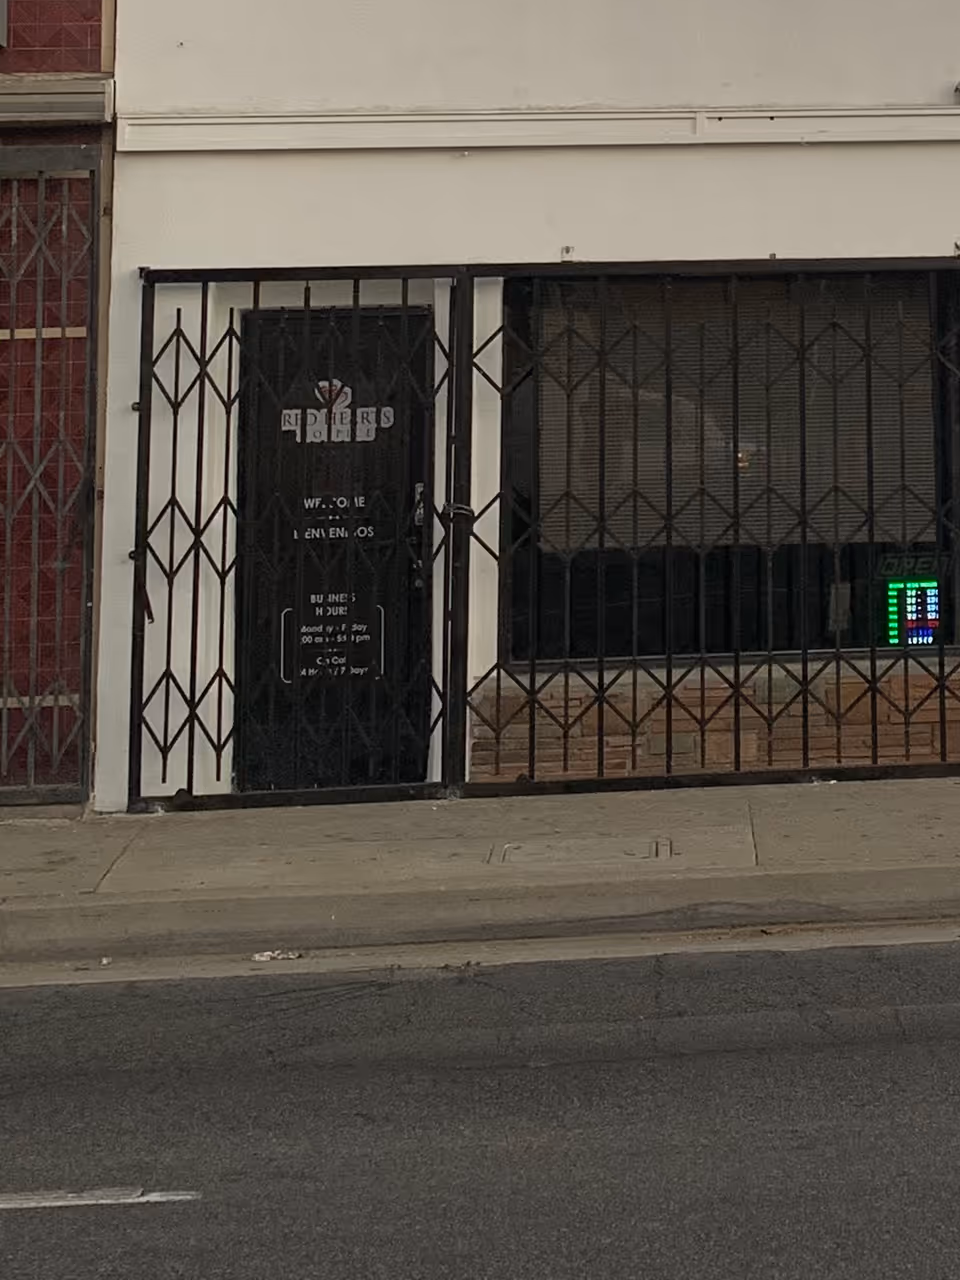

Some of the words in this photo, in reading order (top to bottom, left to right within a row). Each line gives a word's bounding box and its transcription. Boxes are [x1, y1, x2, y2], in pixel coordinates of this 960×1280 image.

[325, 410, 392, 425] HERS
[303, 496, 366, 509] WEOME
[292, 526, 375, 540] ENVENIOS
[310, 593, 356, 603] BUINESS
[341, 623, 367, 633] Fday
[331, 656, 347, 665] Cal
